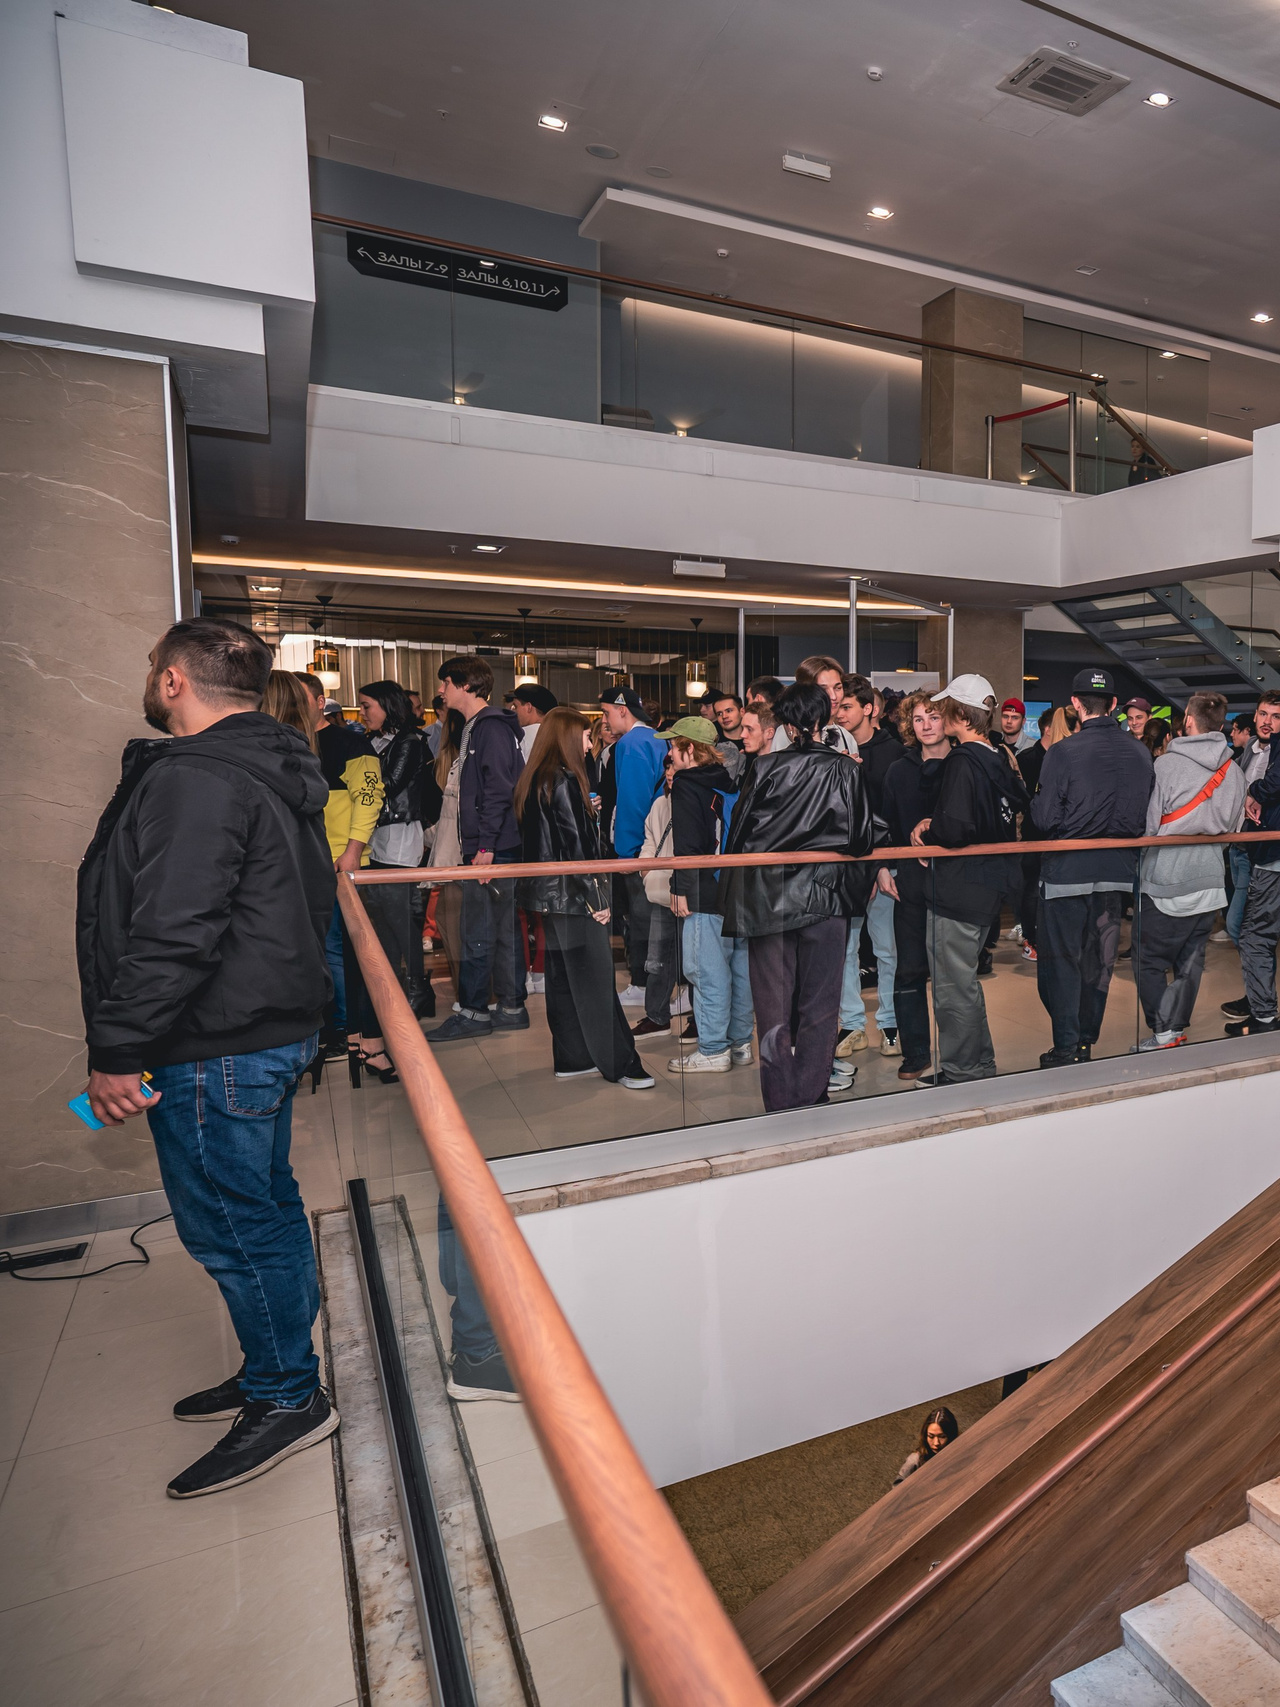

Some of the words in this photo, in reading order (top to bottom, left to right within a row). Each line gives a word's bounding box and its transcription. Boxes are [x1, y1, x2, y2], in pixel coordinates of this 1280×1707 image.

[378, 251, 421, 269] ЗАЛЫ
[425, 260, 449, 274] 7-9
[457, 268, 499, 285] ЗАЛЫ
[502, 277, 544, 294] 6,10,11
